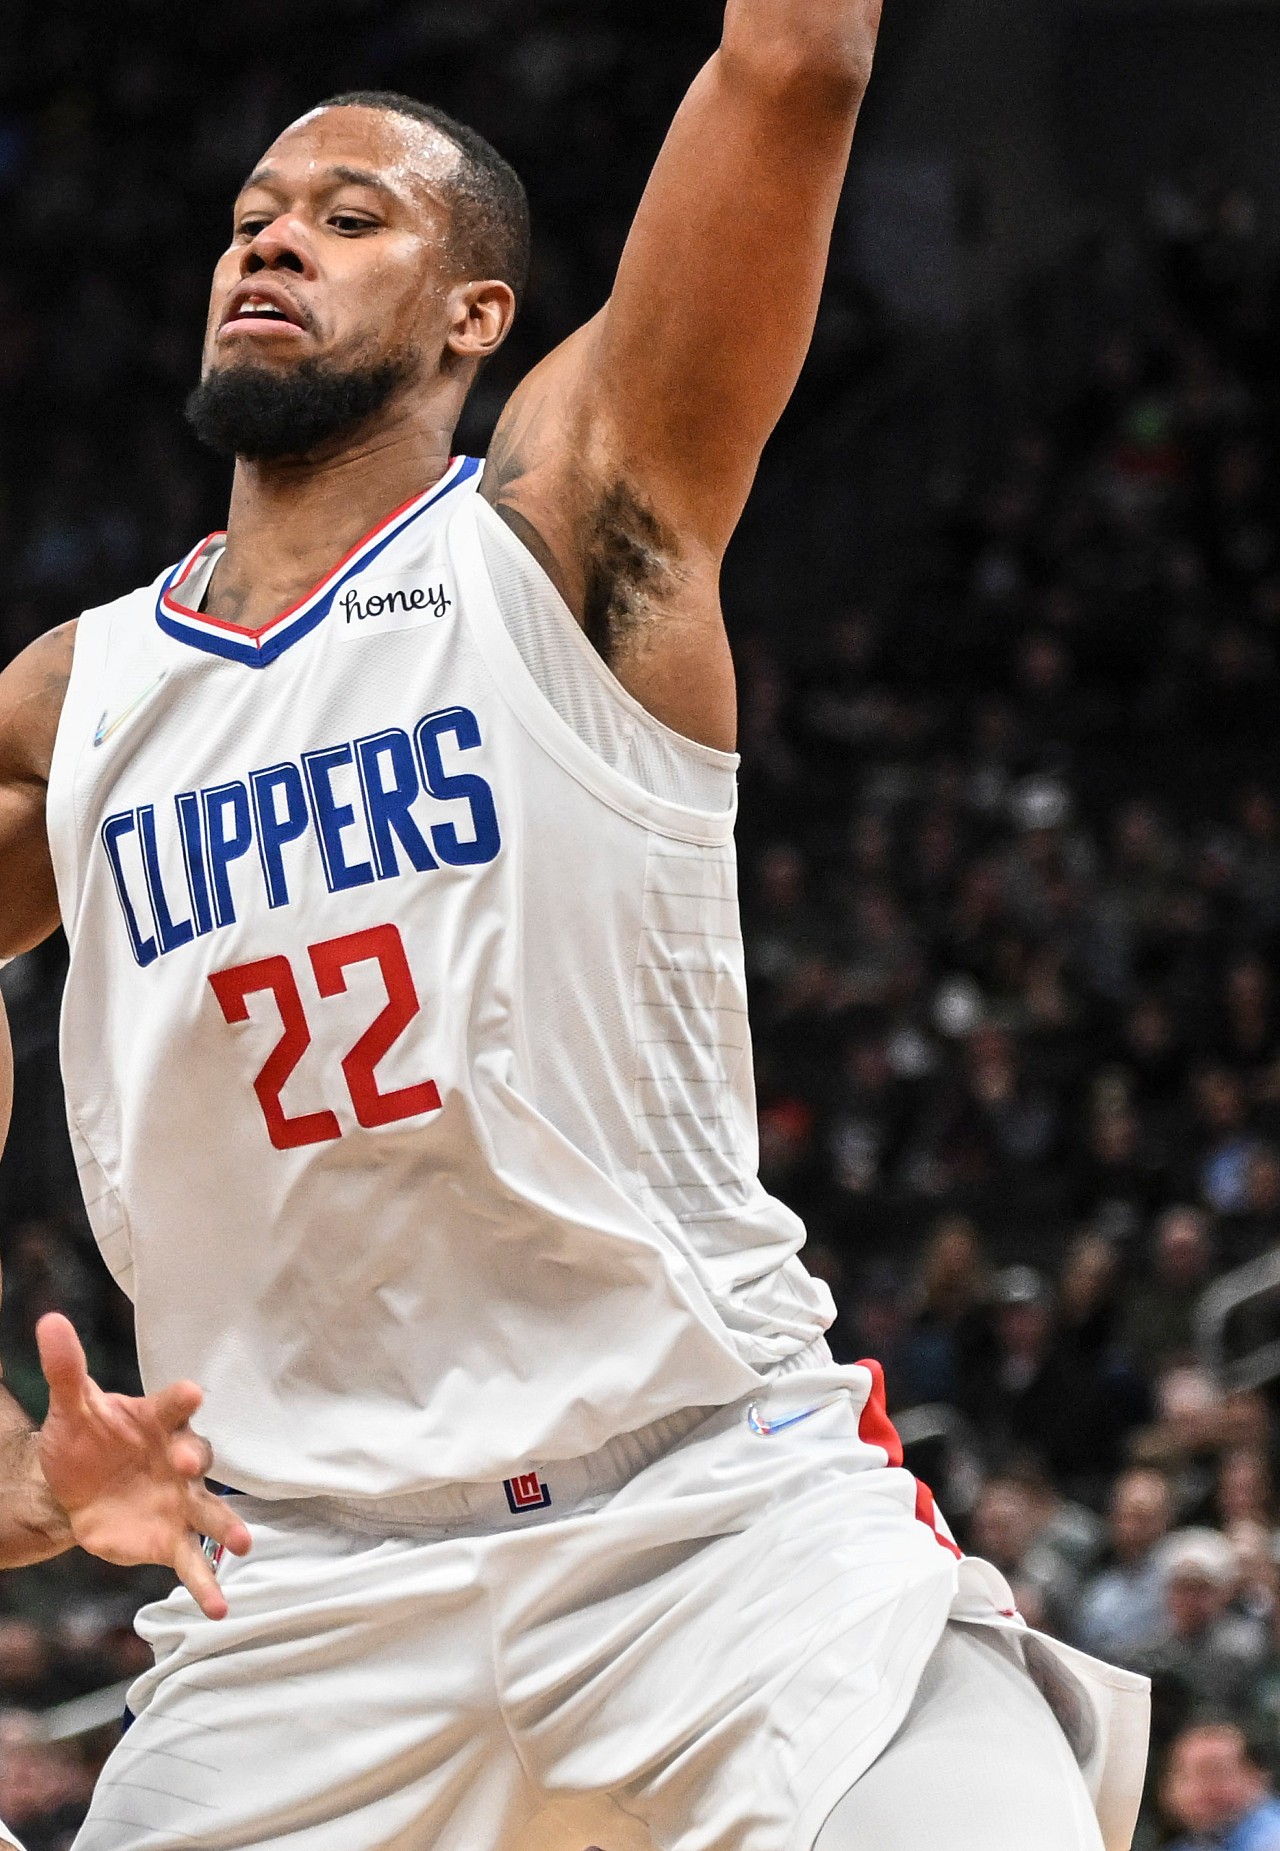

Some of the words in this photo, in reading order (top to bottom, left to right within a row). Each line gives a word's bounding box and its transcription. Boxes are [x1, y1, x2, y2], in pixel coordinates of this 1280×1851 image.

[339, 583, 451, 624] honey
[101, 706, 502, 968] CLIPPERS
[207, 922, 443, 1150] 22
